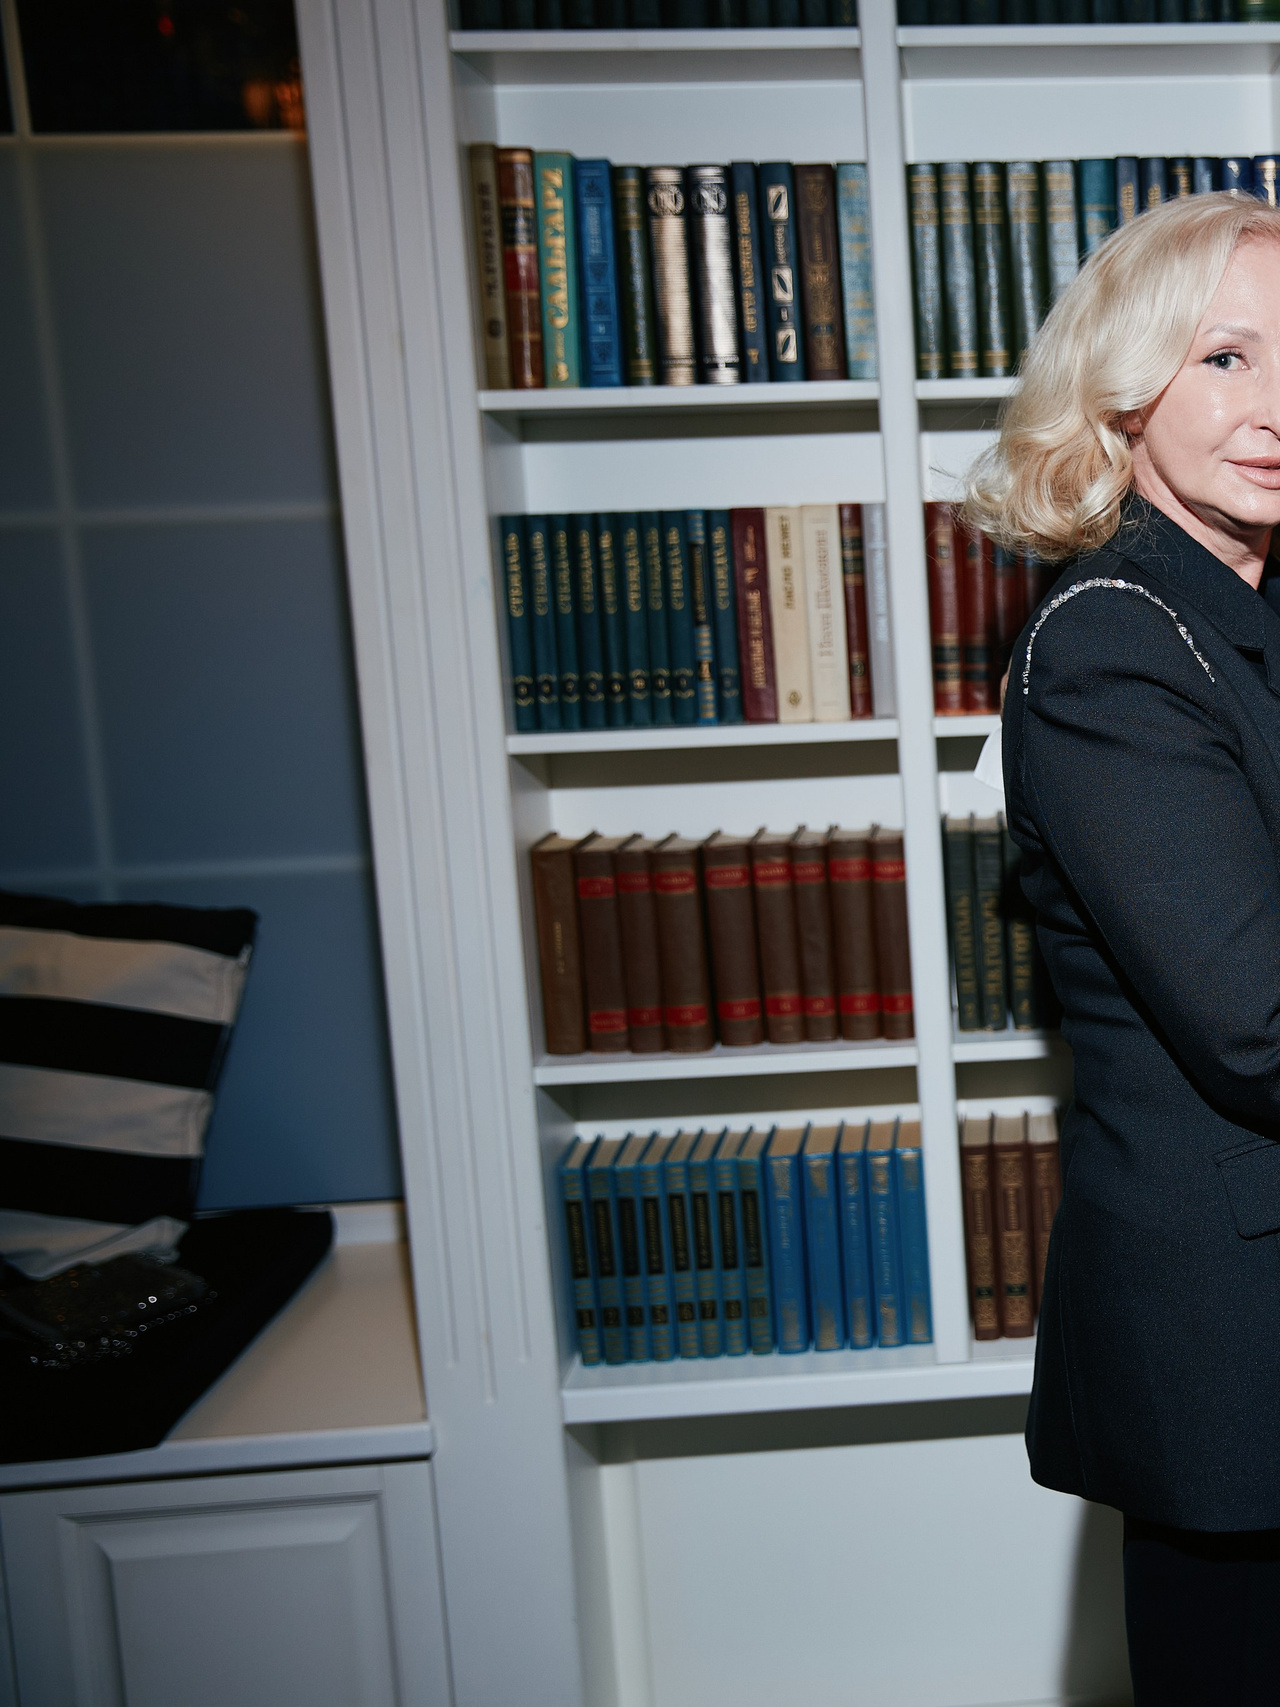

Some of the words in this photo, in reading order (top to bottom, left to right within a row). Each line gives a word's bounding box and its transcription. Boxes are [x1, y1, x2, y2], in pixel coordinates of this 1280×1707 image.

[540, 167, 569, 330] САЛЬГАРИ
[504, 532, 525, 618] СТЕНДАЛЬ
[530, 531, 549, 616] СТЕНДАЛЬ
[555, 530, 572, 615] СТЕНДАЛЬ
[577, 529, 595, 614] СТЕНДАЛЬ
[598, 530, 618, 615] СТЕНДАЛЬ
[623, 528, 642, 612] СТЕНДАЛЬ
[645, 527, 663, 611] СТЕНДАЛЬ
[666, 527, 685, 610] СТЕНДАЛЬ
[711, 526, 730, 610] СТЕНДАЛЬ
